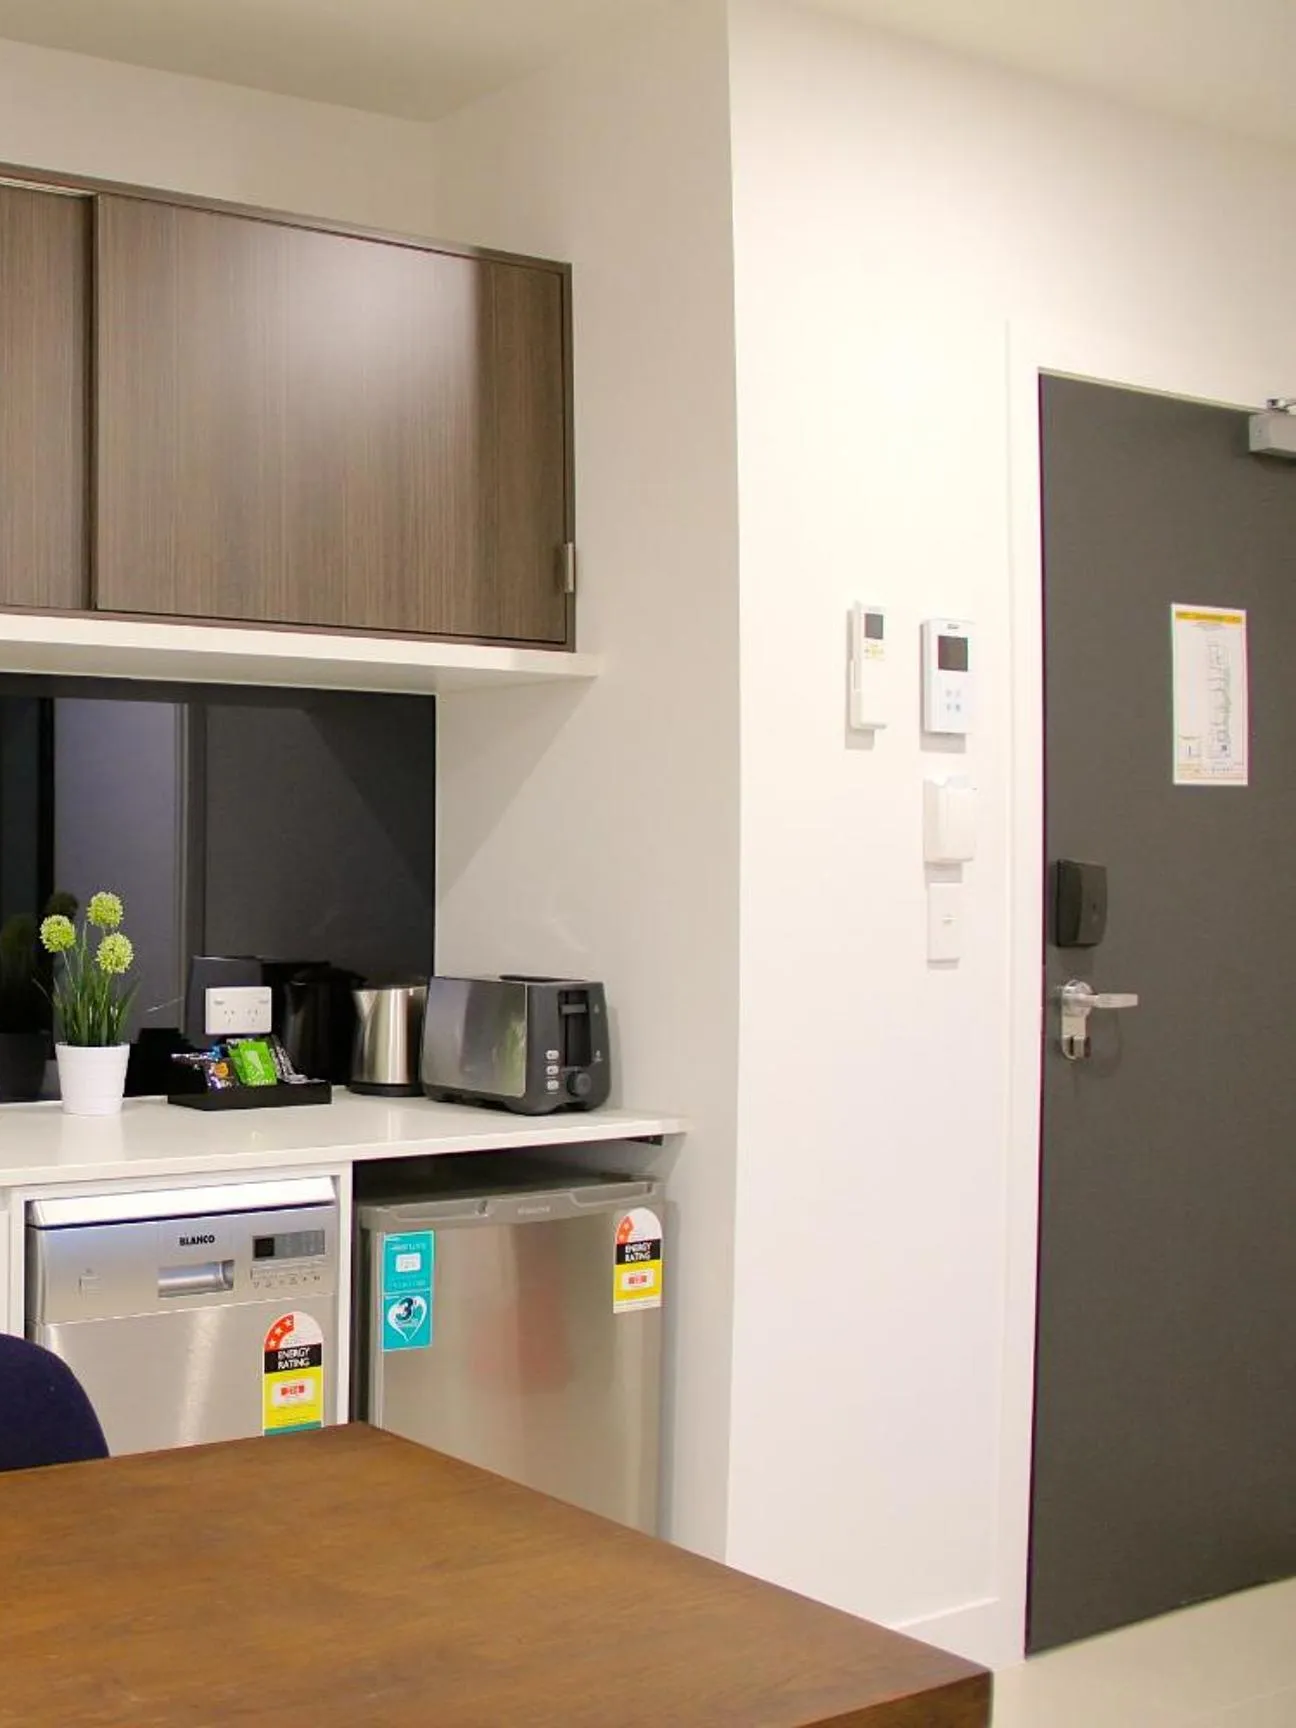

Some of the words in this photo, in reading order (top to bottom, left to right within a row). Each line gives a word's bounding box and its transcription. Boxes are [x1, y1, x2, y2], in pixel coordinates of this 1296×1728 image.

[179, 1235, 216, 1246] BLANCO
[625, 1242, 653, 1254] ENERGY
[625, 1251, 652, 1263] RATING
[277, 1346, 311, 1360] ENERGY
[277, 1358, 311, 1370] RATING
